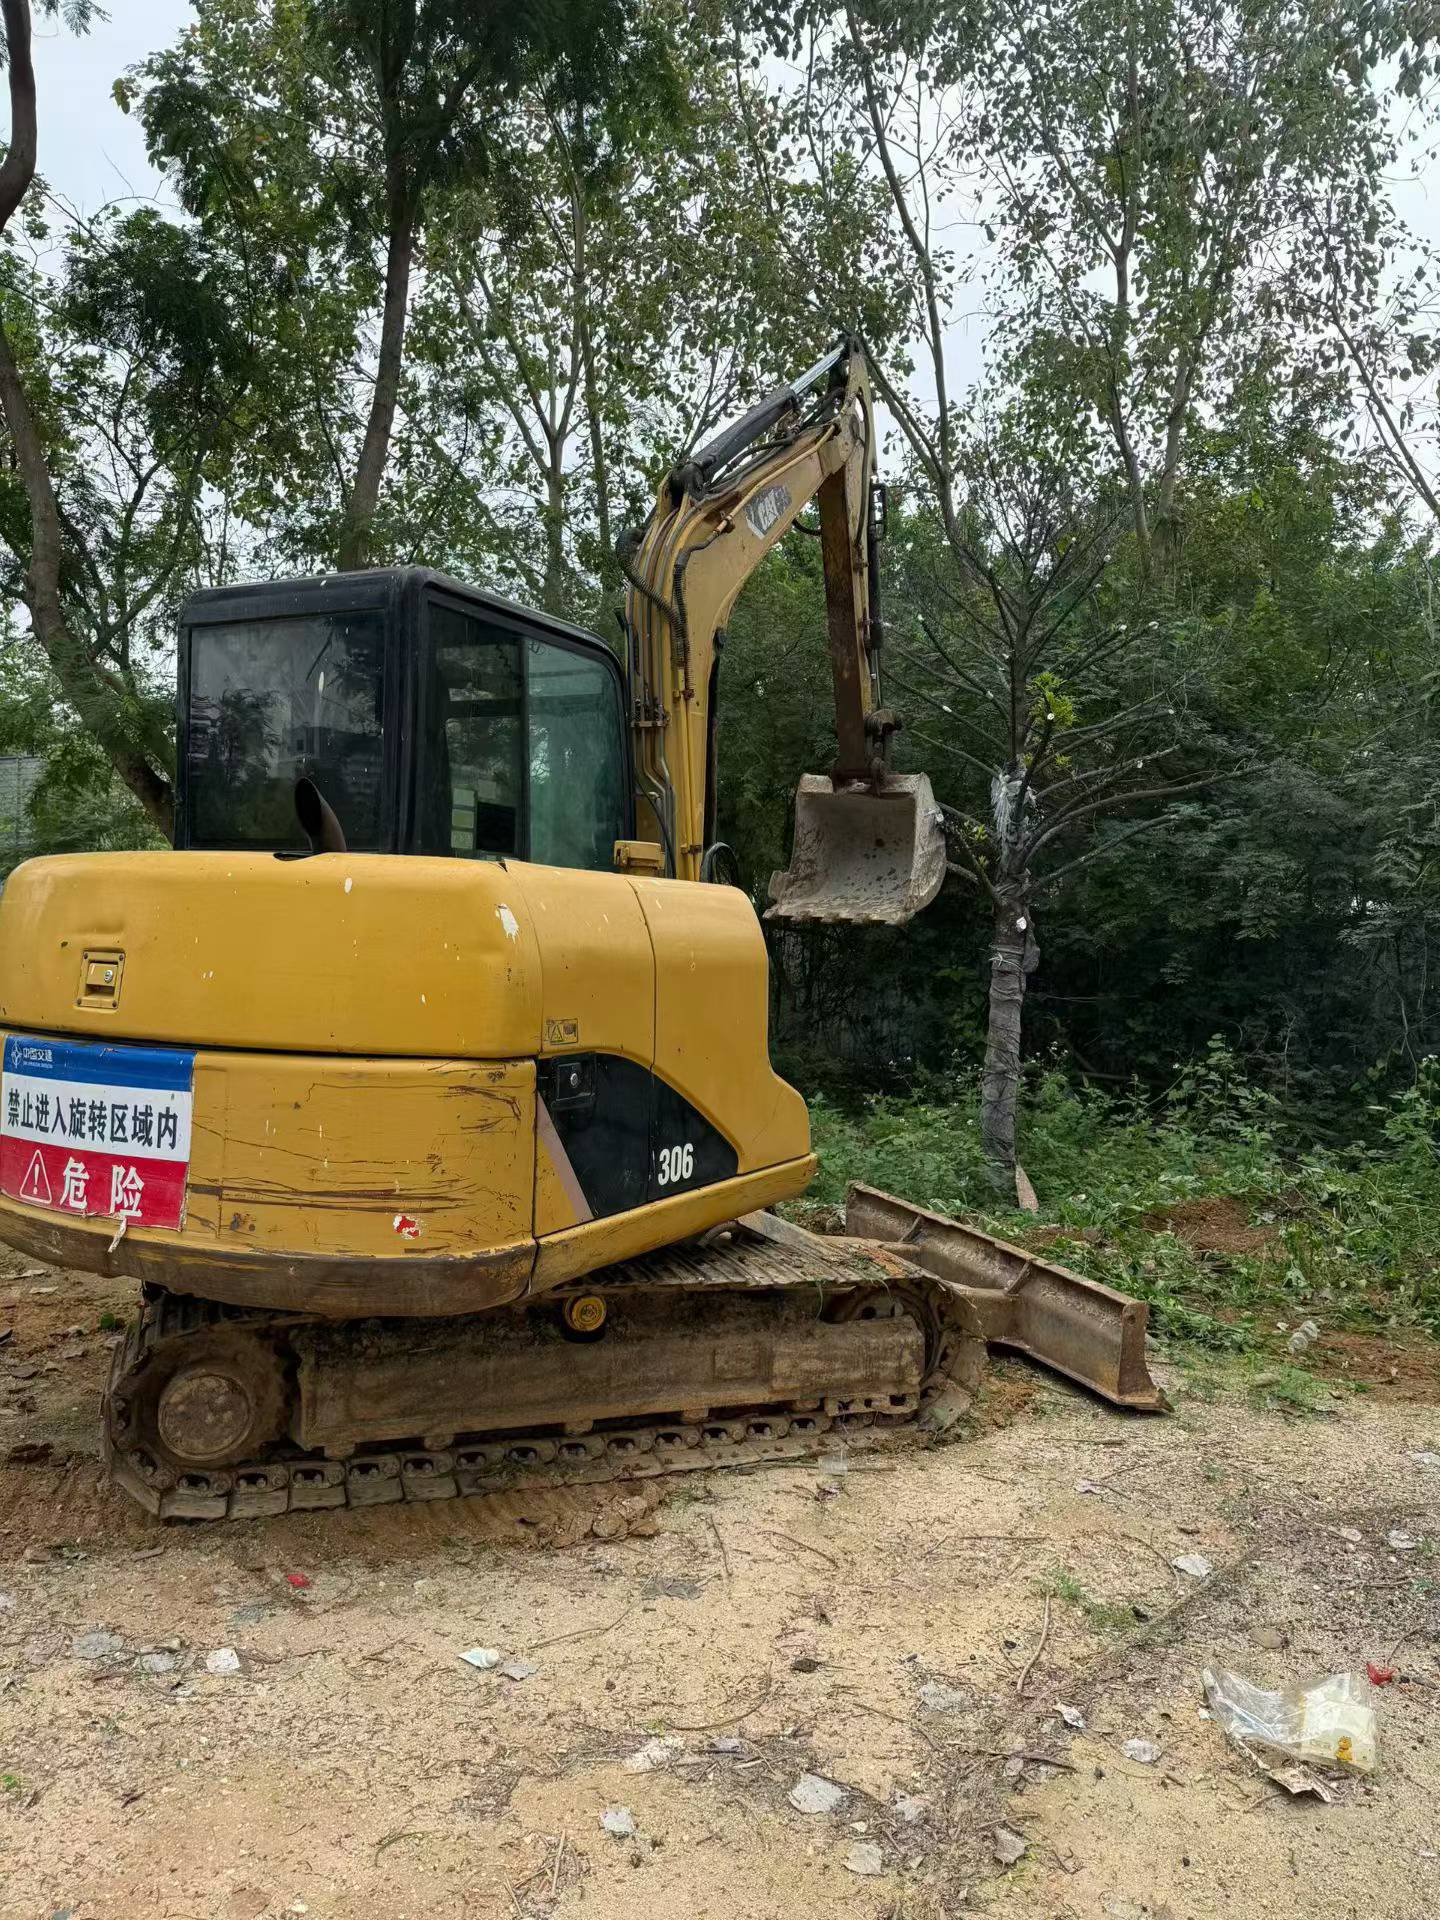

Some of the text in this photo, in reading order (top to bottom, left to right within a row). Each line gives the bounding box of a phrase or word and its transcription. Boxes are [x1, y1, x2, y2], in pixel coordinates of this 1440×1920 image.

[7, 1088, 179, 1150] 禁止进入旋转区域内
[60, 1156, 145, 1217] 危险
[658, 1143, 693, 1186] 306
